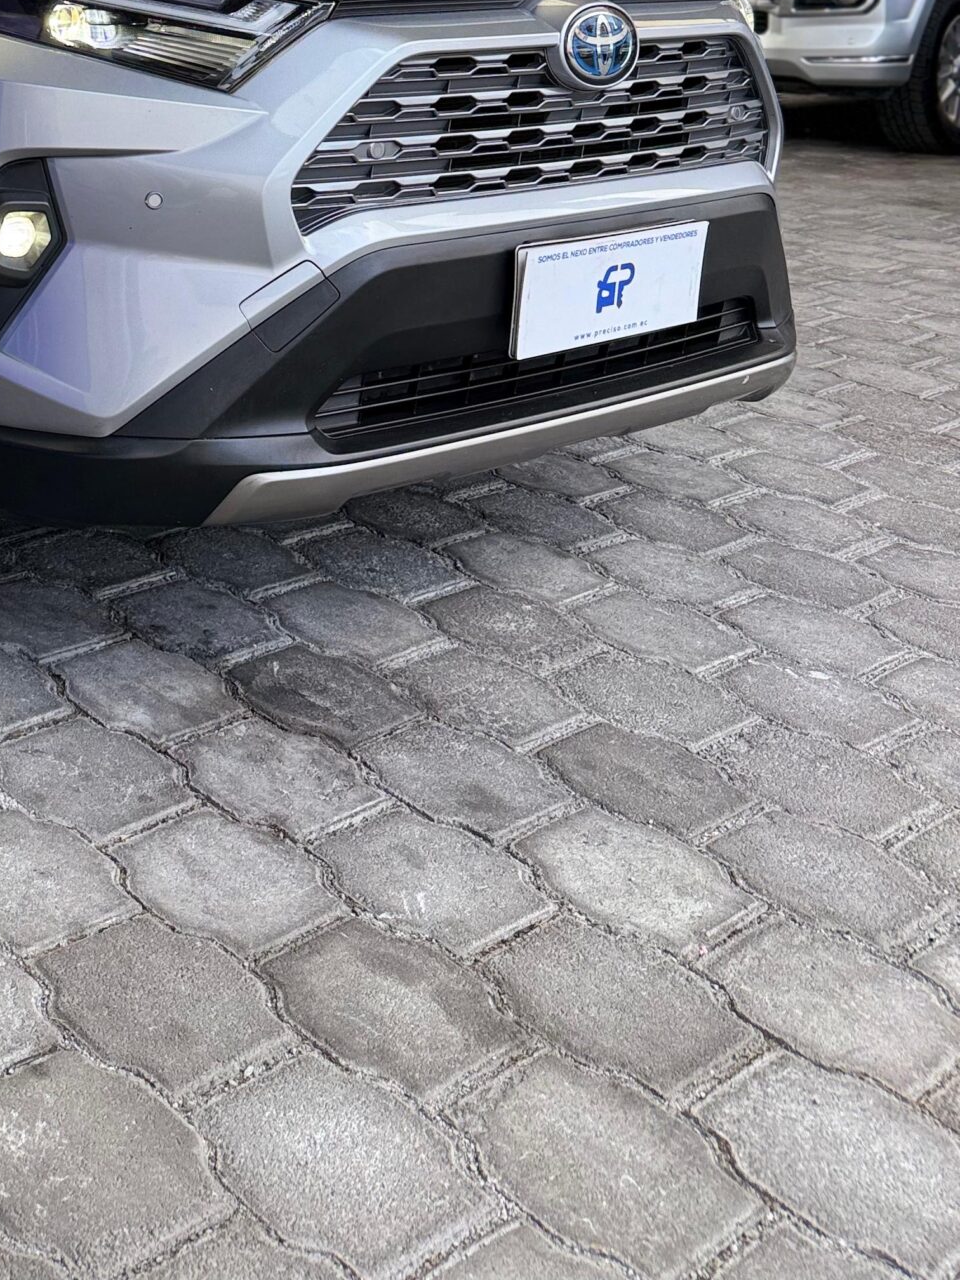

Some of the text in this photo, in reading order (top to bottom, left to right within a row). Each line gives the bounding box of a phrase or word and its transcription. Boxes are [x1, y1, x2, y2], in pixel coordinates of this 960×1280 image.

[538, 252, 561, 264] SOMOS
[561, 251, 569, 260] EL
[570, 248, 588, 257] NEXO
[588, 244, 609, 255] ENTRE
[608, 236, 654, 252] COMPRADORES
[659, 229, 698, 242] VENDEDORES
